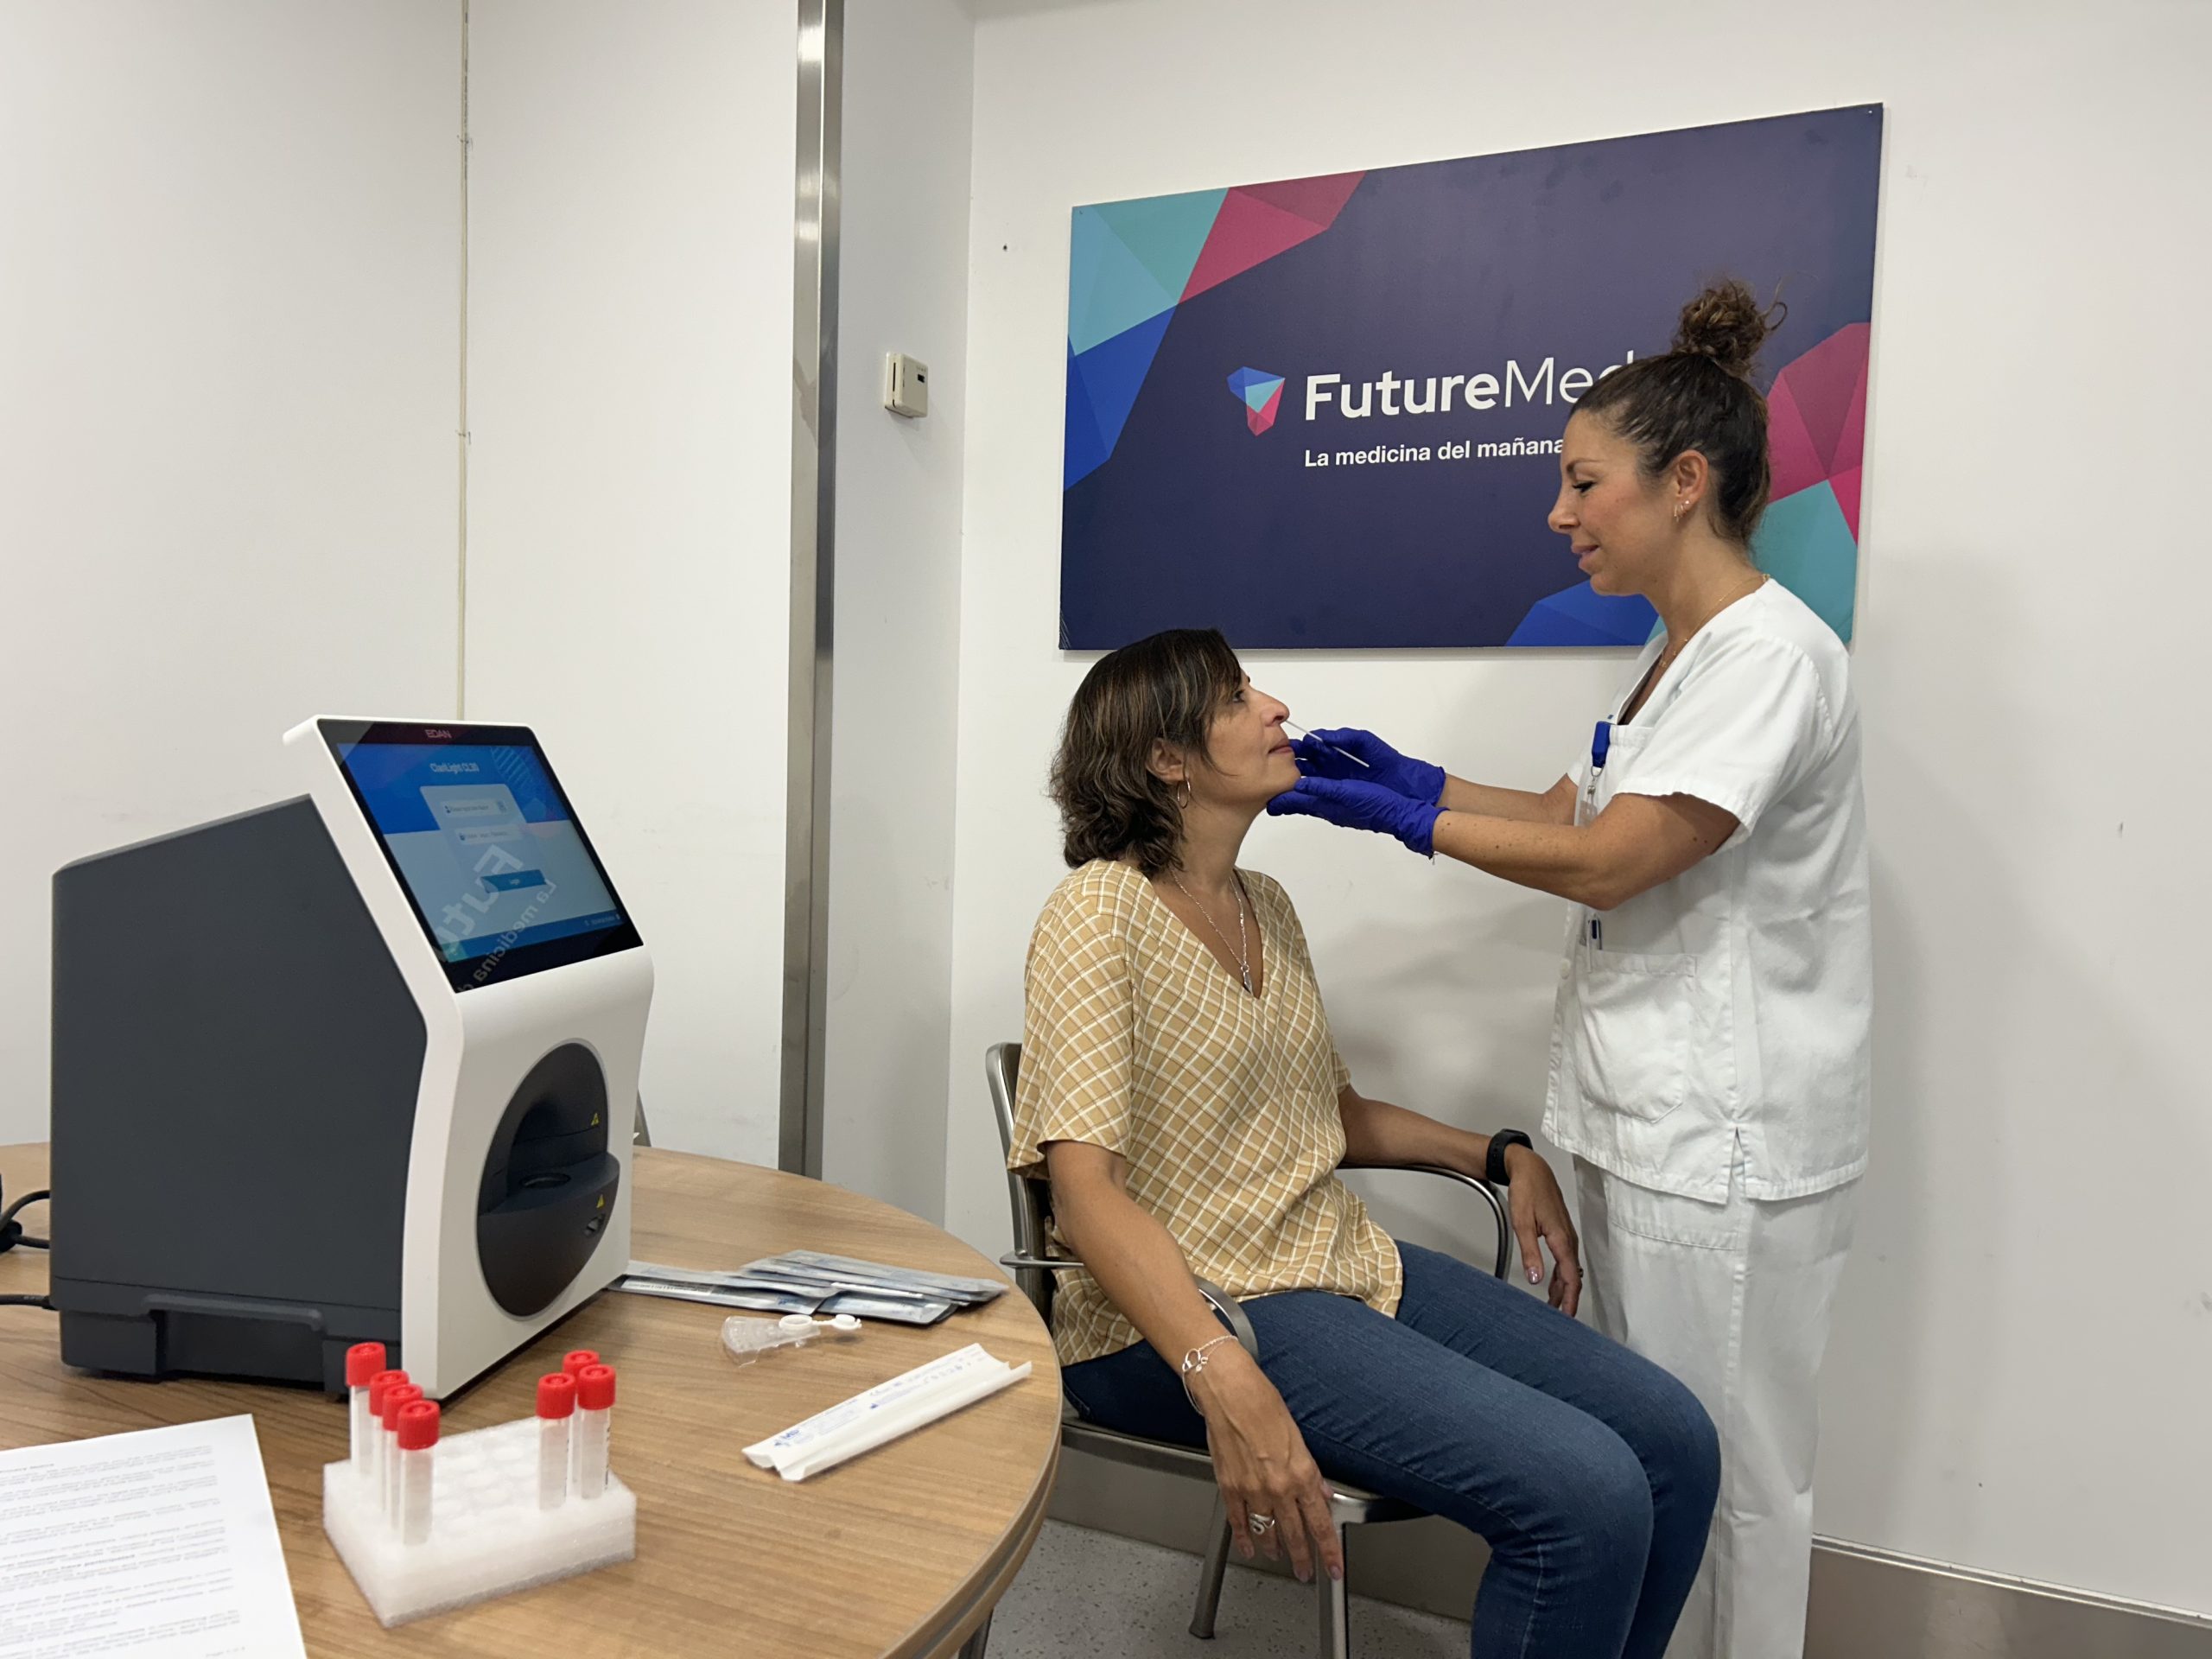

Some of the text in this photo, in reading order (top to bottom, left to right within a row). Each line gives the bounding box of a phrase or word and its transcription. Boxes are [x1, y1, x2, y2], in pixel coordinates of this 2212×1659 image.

[1305, 437, 1564, 467] La medicina del mañana
